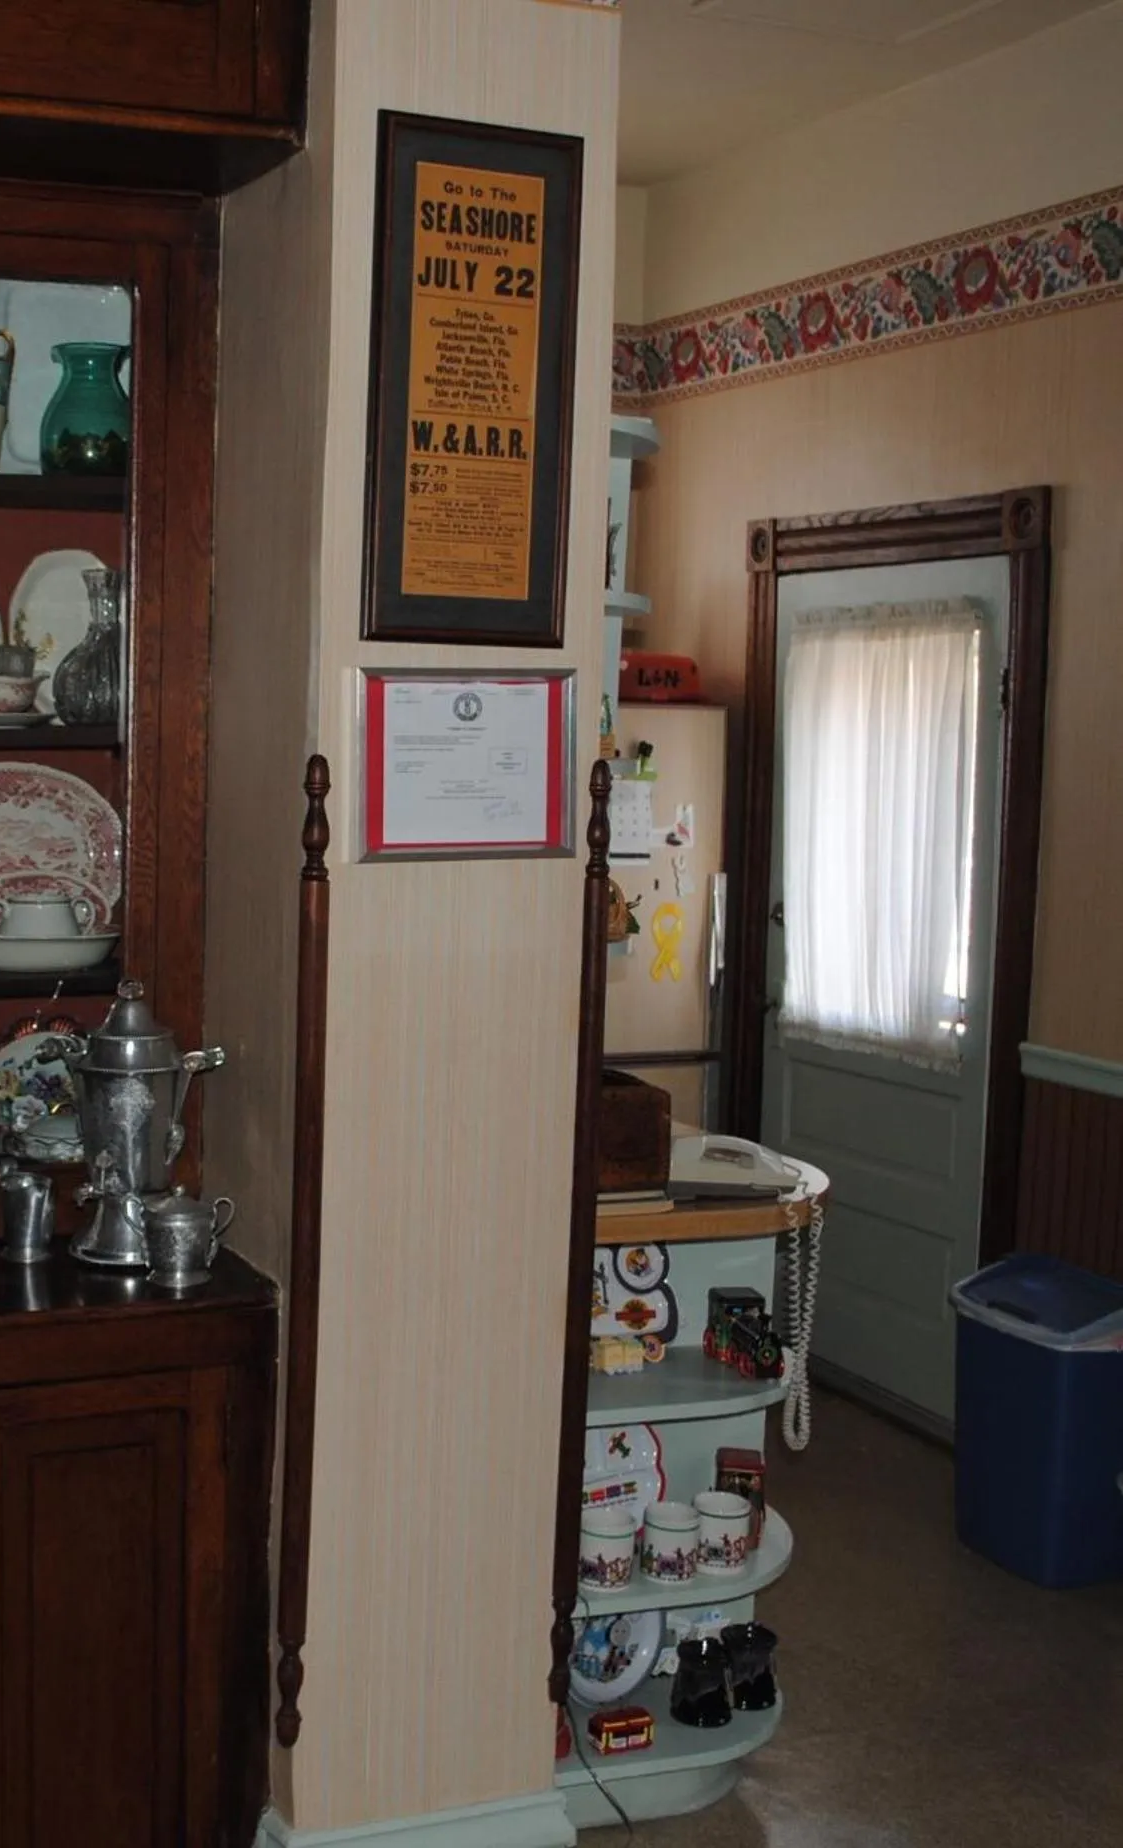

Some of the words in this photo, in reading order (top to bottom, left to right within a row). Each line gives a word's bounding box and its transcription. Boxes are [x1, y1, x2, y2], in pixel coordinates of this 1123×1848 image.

[444, 181, 464, 195] Go
[470, 184, 484, 198] to
[490, 187, 518, 202] The
[420, 200, 537, 245] SEASHORE
[445, 240, 510, 257] SATURDAY
[417, 256, 479, 292] JULY
[494, 265, 536, 299] 22
[410, 462, 448, 478] $7.75
